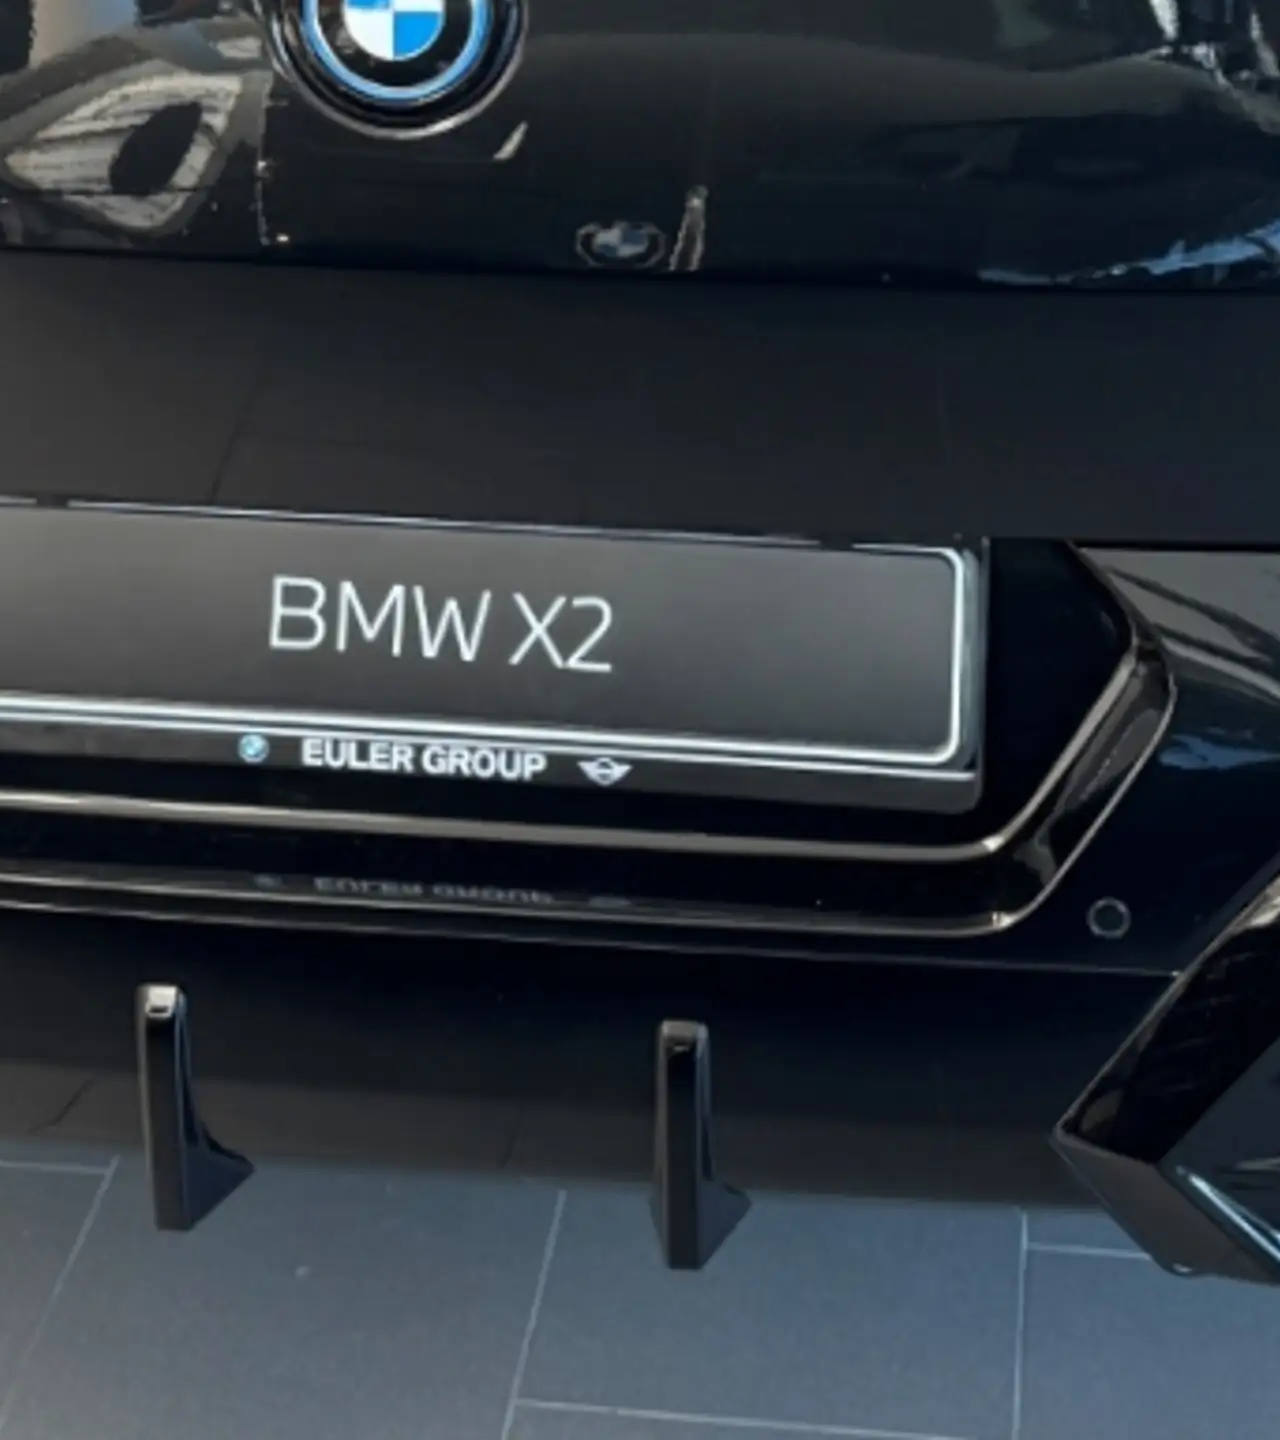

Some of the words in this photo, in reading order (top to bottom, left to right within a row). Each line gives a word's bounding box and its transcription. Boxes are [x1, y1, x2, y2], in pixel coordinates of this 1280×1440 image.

[268, 573, 493, 664] BMW
[507, 589, 614, 674] X2
[300, 736, 417, 774] EULER
[420, 741, 548, 781] GROUP
